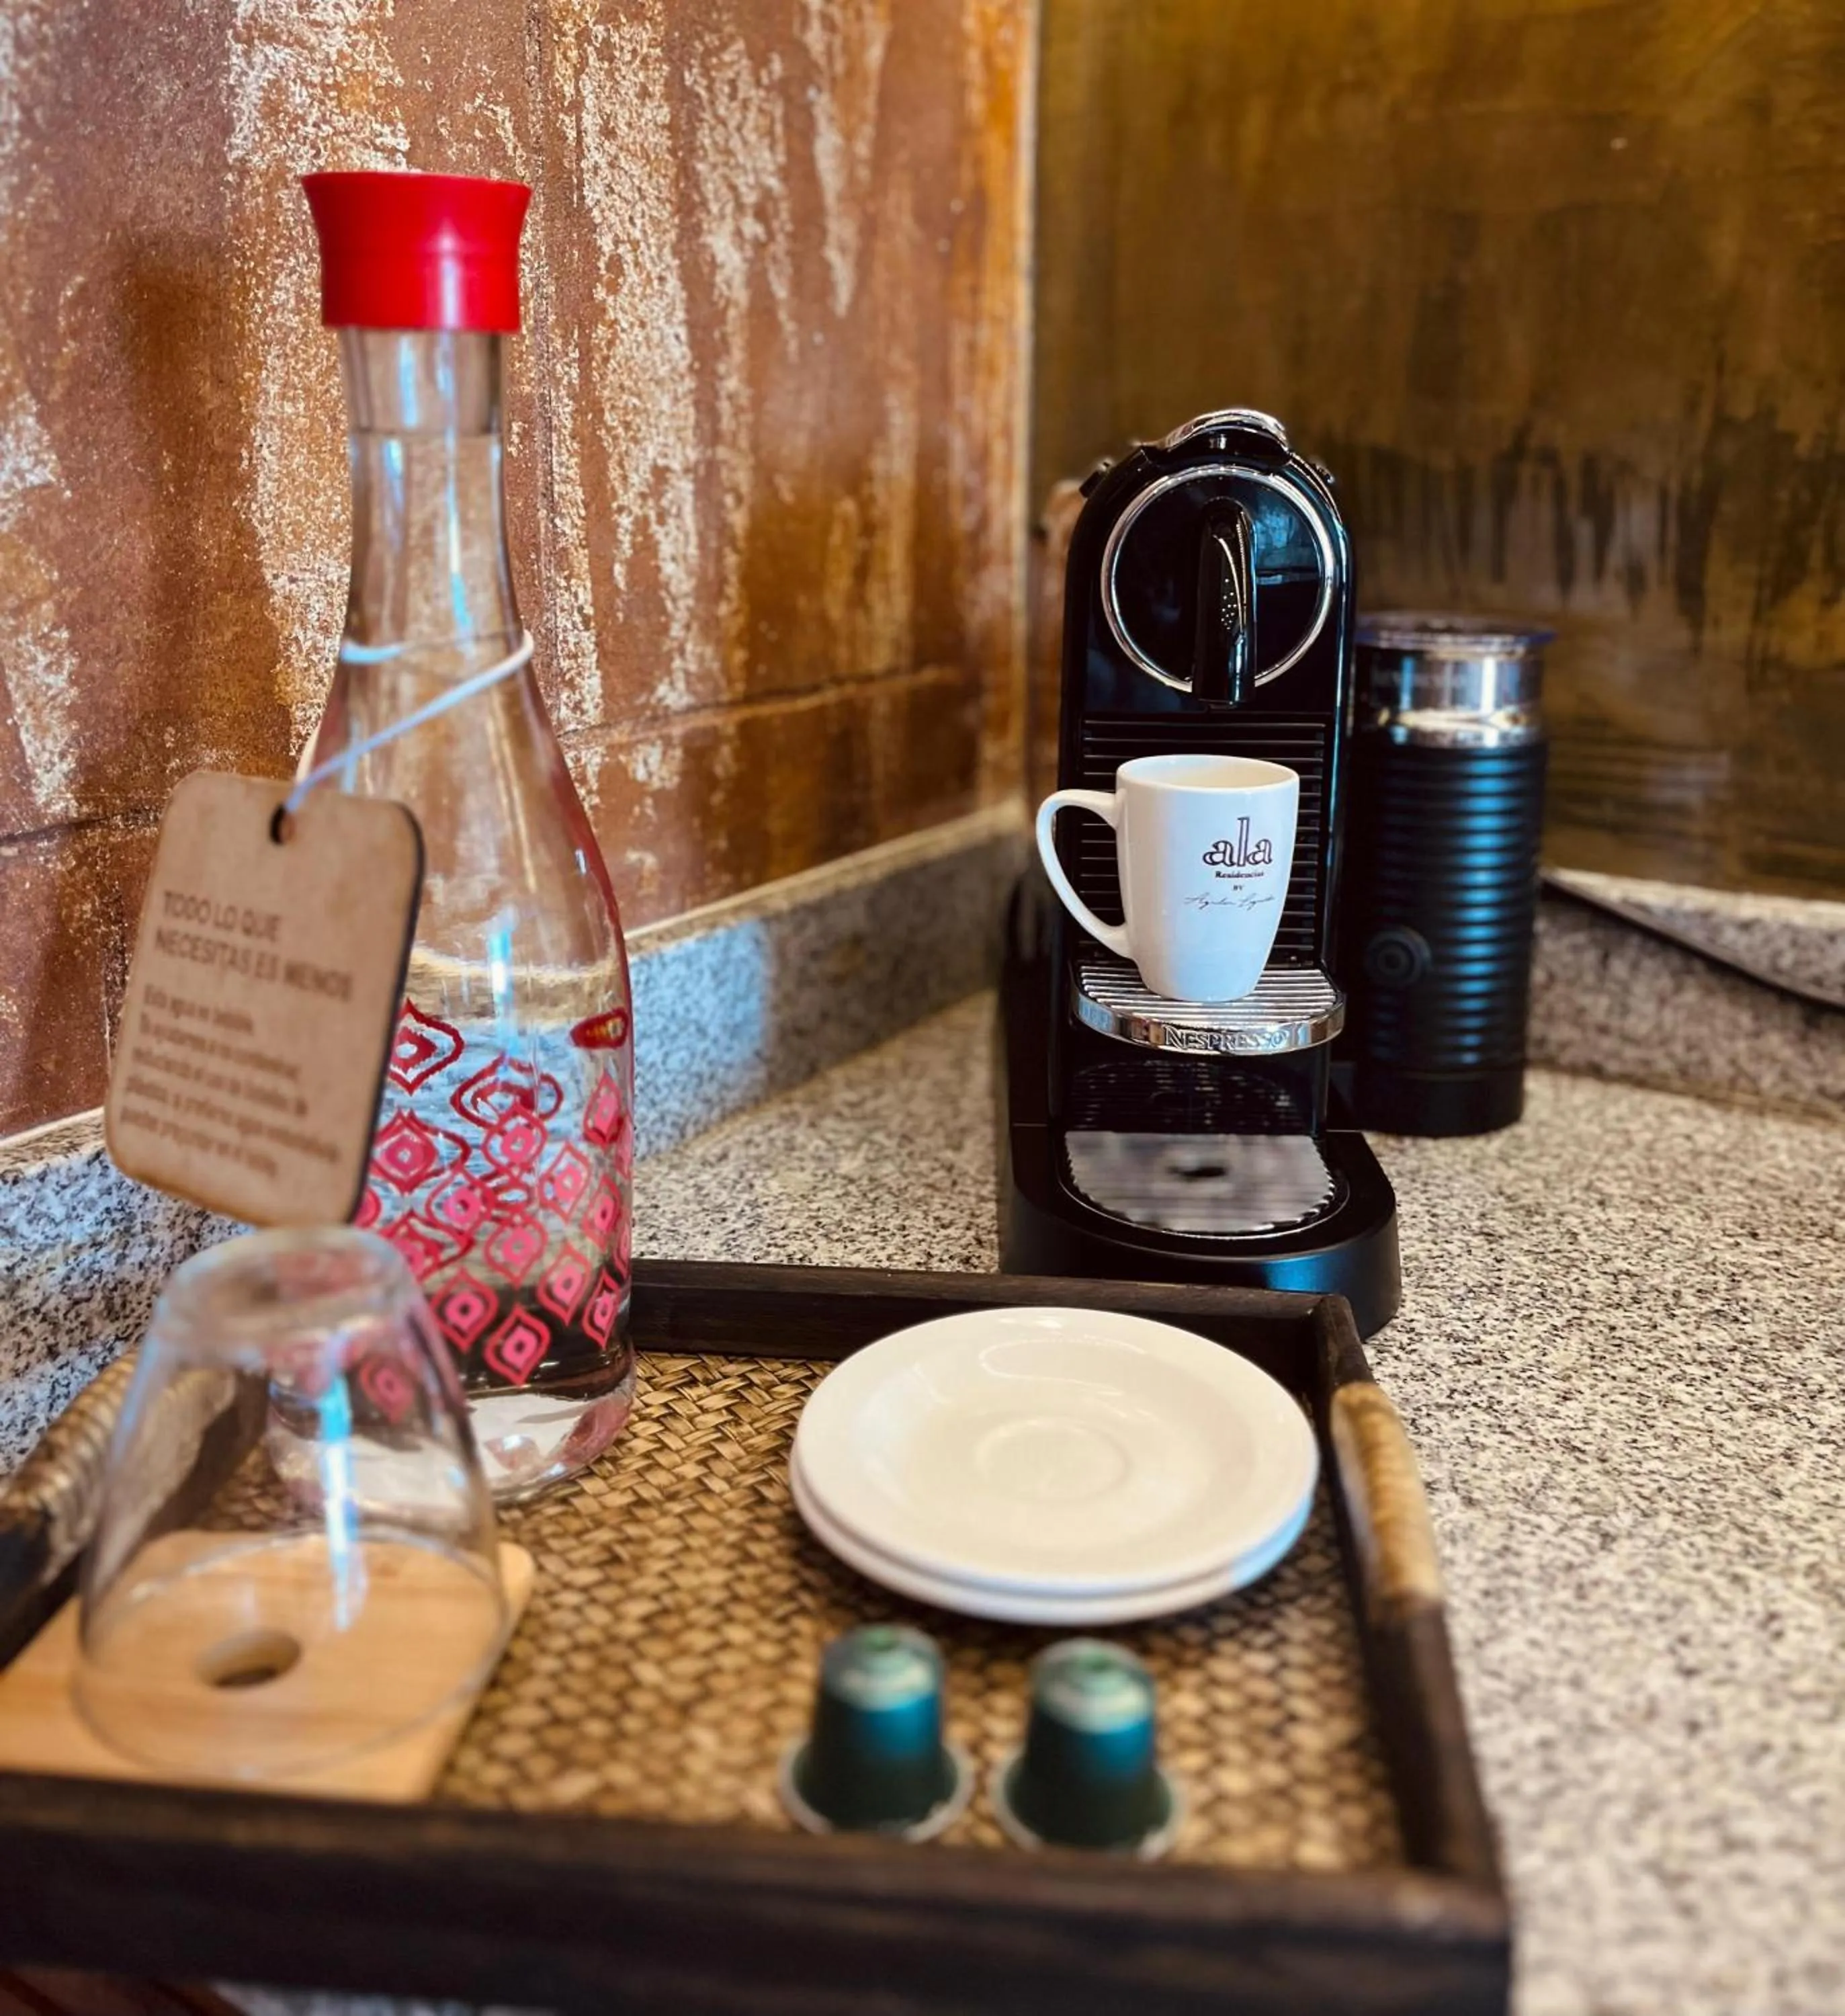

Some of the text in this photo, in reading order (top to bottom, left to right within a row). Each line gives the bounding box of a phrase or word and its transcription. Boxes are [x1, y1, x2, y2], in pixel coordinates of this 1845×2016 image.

[164, 890, 281, 943] TODO LO QUE
[155, 925, 253, 975] NECESITAS
[1163, 1024, 1290, 1052] NESPRESSO
